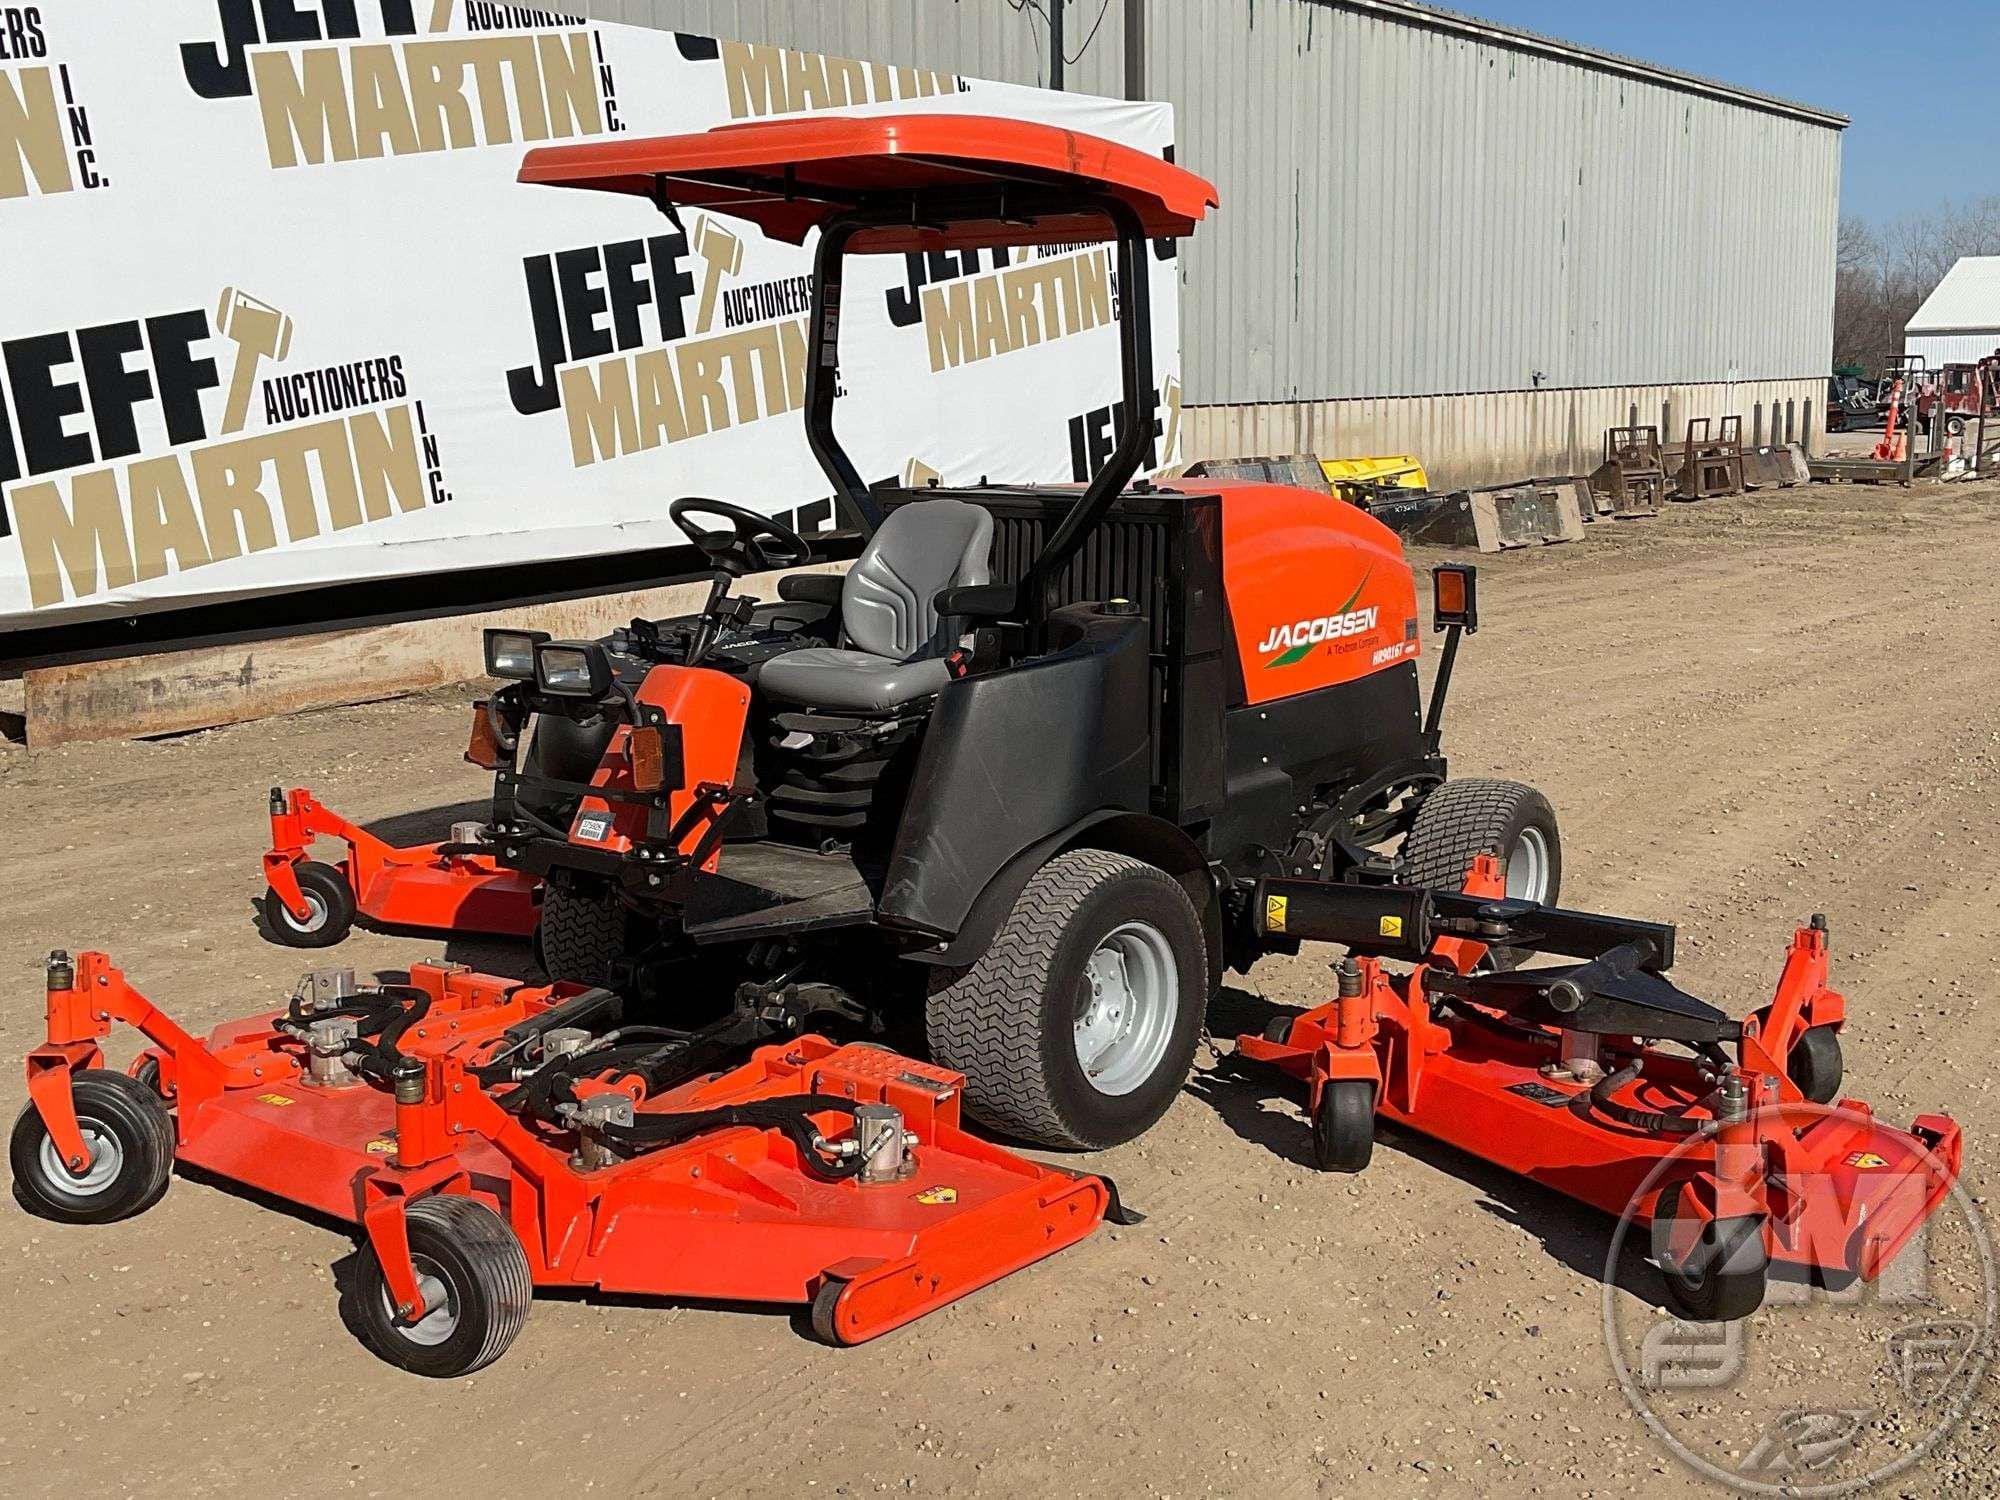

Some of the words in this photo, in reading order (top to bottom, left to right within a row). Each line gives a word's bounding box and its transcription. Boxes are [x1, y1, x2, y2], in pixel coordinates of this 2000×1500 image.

[59, 64, 110, 189] INC.
[251, 32, 603, 169] MARTIN
[594, 30, 627, 132] INC.
[507, 233, 695, 415] JEFF
[923, 250, 1111, 373] MARTIN
[0, 309, 220, 537] EFF
[263, 355, 408, 425] AUCTIONEERS
[416, 400, 453, 504] INC.
[10, 405, 426, 609] MARTIN
[1258, 605, 1380, 654] JACOBSEN
